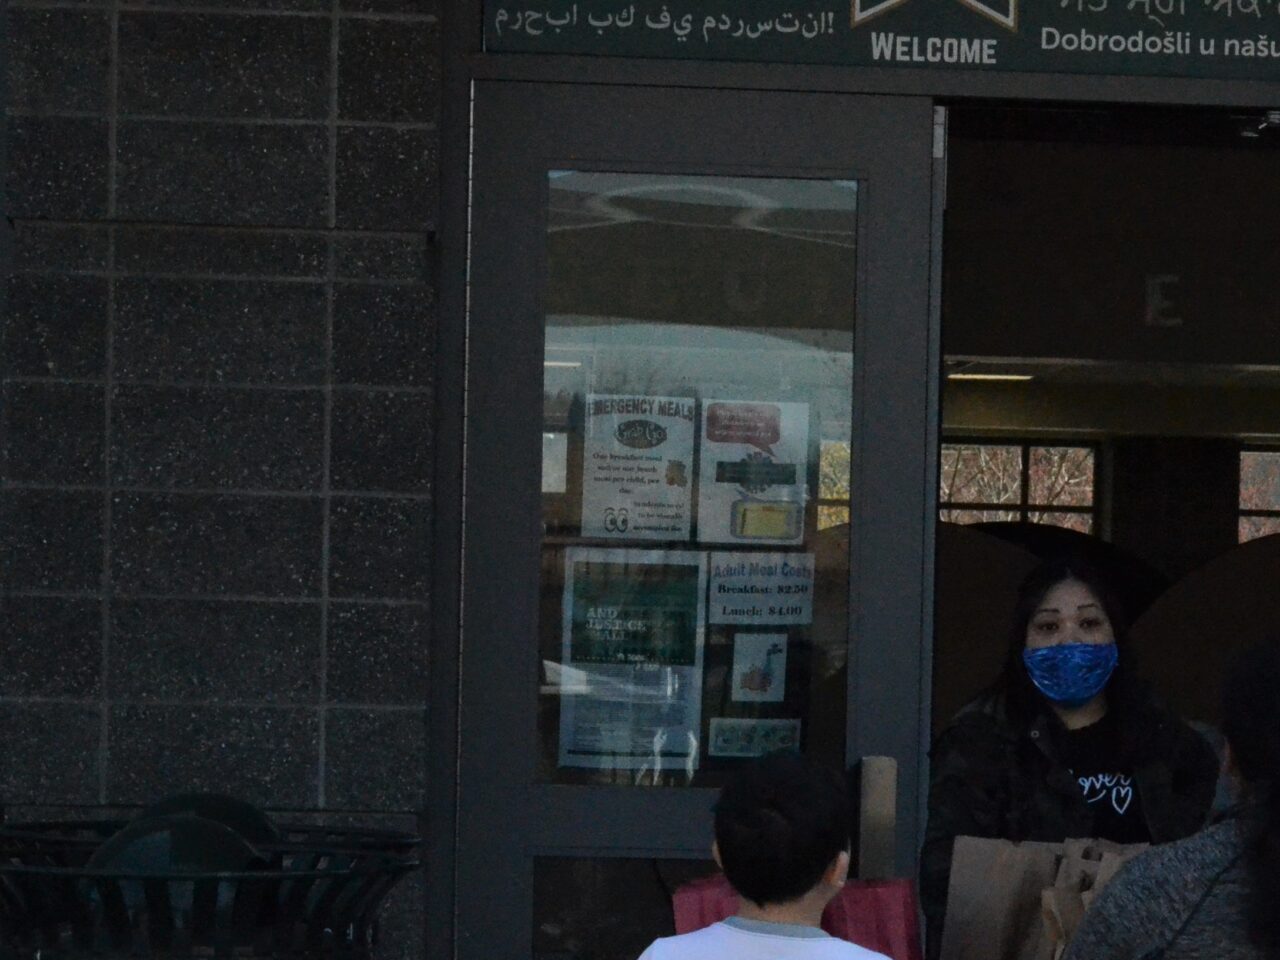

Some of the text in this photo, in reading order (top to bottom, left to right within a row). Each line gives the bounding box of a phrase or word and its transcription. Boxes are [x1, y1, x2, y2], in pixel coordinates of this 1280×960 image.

[870, 31, 998, 65] WELCOME
[1040, 26, 1192, 56] Dobrodošli
[1199, 36, 1216, 56] u
[1144, 273, 1183, 327] E
[587, 398, 693, 421] EMERGENCY MEALS
[714, 561, 812, 579] Adult Meal Costs
[718, 583, 772, 594] Breakfast:
[585, 606, 619, 619] AND
[722, 606, 762, 617] Lunch:
